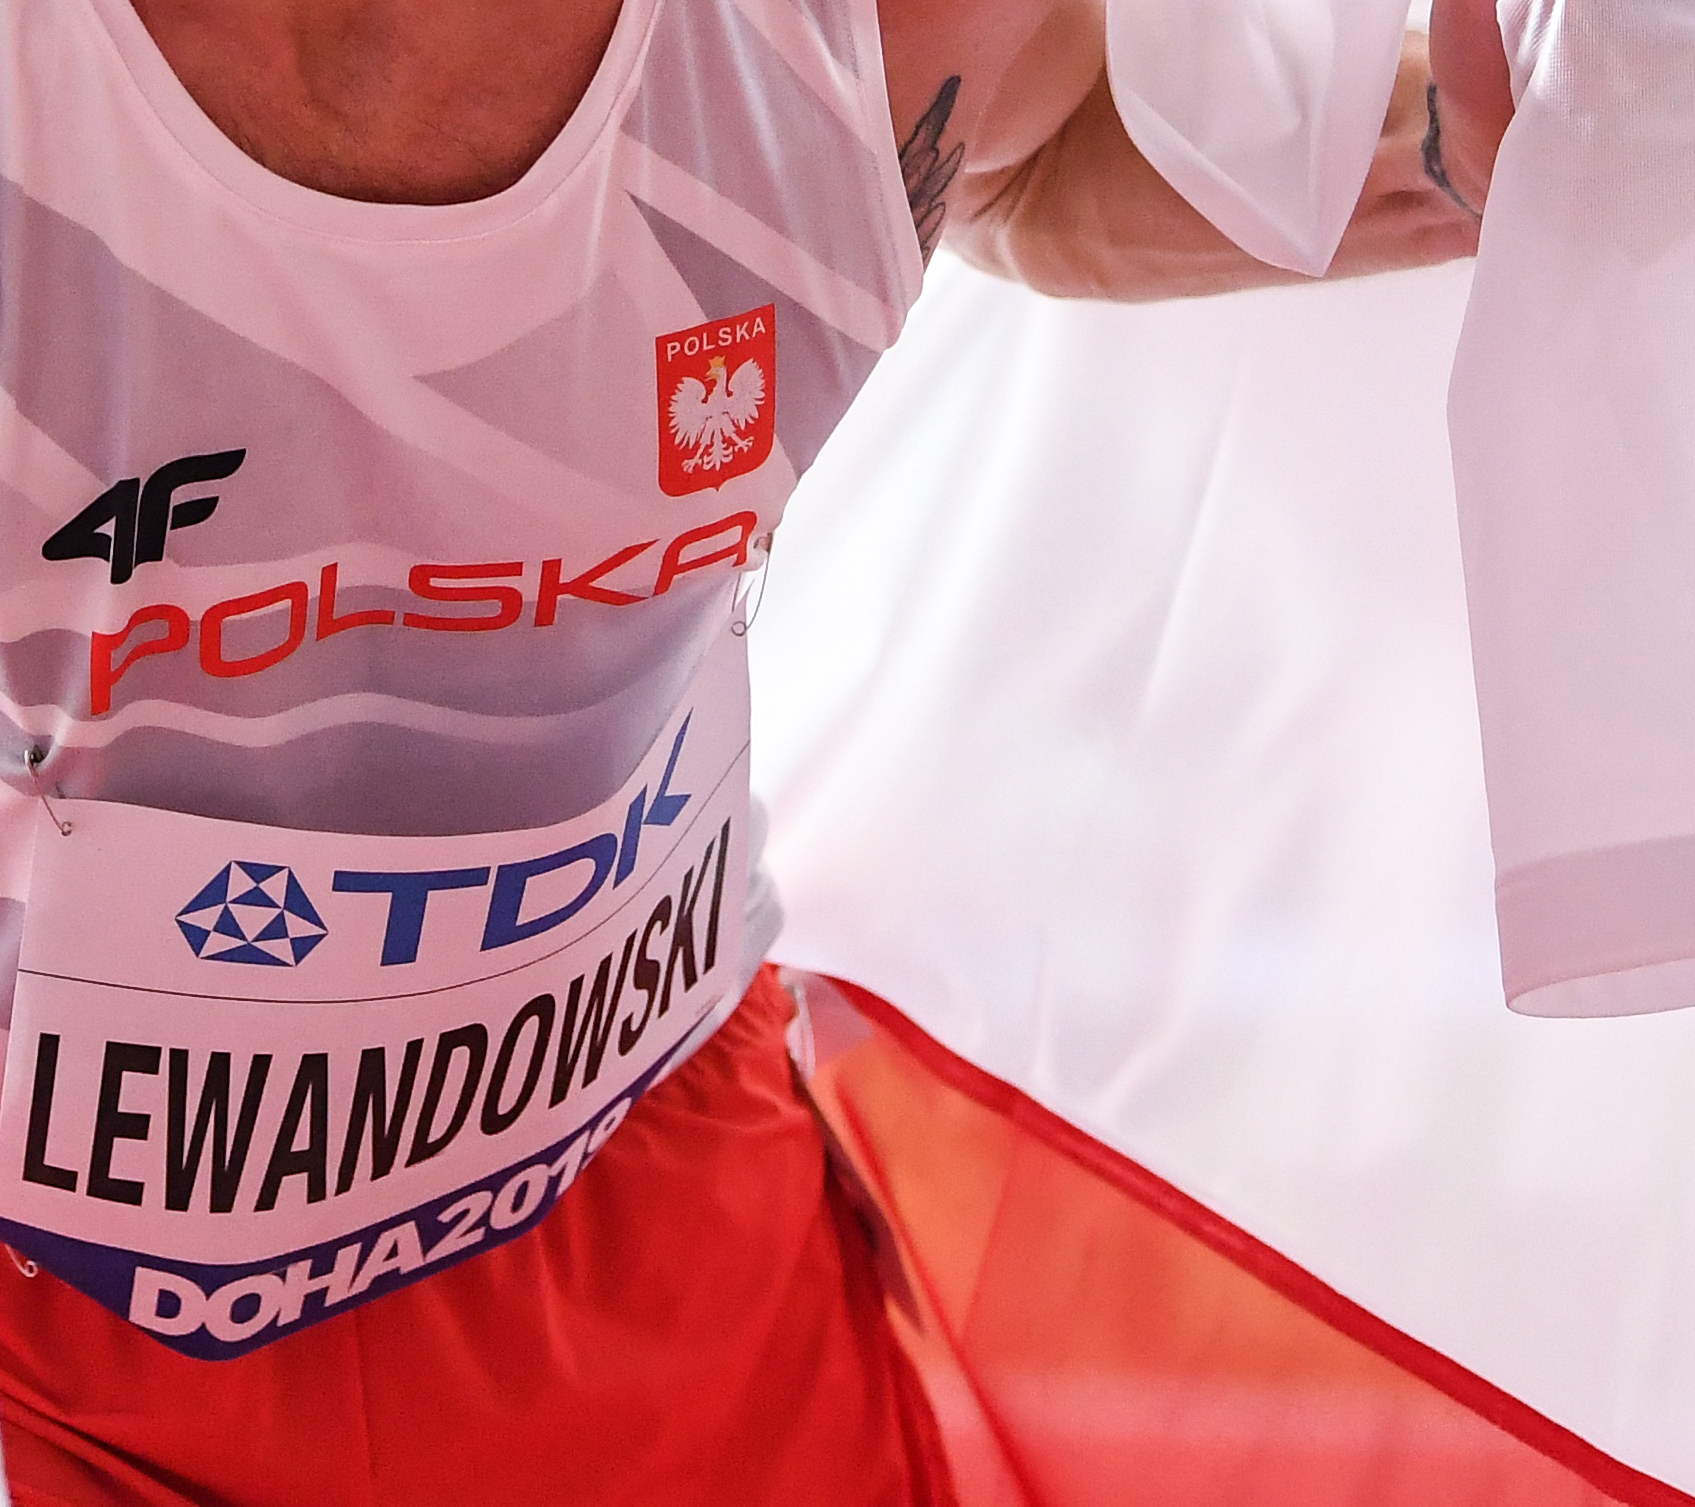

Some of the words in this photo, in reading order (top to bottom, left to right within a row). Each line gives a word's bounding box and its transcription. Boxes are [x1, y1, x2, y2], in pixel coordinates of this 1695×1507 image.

[666, 317, 766, 362] POLSKA
[42, 449, 246, 584] 4F
[90, 510, 758, 716] POLSKA
[331, 707, 693, 967] TDK
[22, 818, 732, 1214] LEWANDOWSKI
